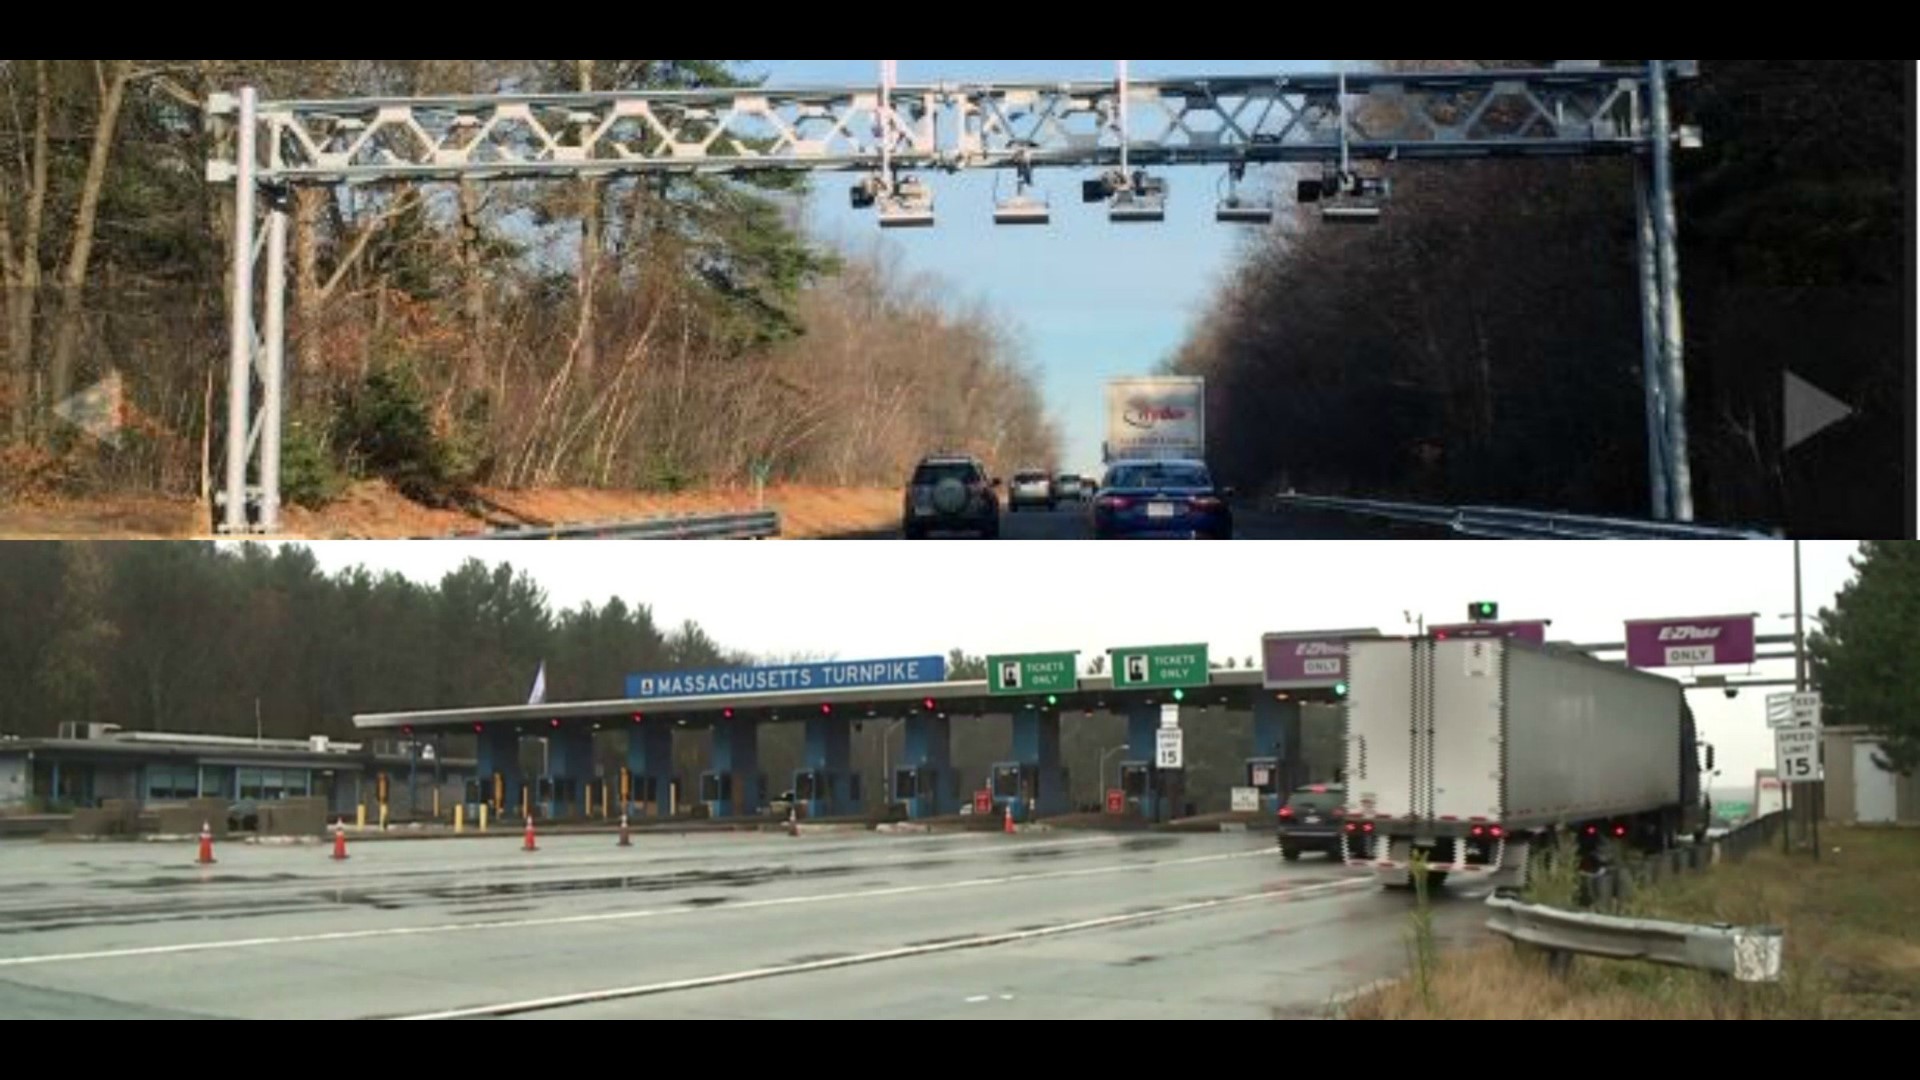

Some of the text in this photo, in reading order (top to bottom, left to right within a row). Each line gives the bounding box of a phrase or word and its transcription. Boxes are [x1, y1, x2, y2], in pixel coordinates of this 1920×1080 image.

[1154, 654, 1195, 666] TICKETS
[1671, 648, 1708, 661] ONLY
[1026, 661, 1064, 673] TICKETS
[1306, 661, 1338, 671] ONLY
[658, 661, 919, 695] MASSACHUSETTS TURNPIKE
[1160, 668, 1189, 679] ONLY
[1032, 675, 1058, 685] ONLY
[1781, 733, 1815, 742] SPEED
[1783, 744, 1811, 755] LIMIT
[1161, 750, 1177, 764] 15
[1785, 758, 1811, 776] 15
